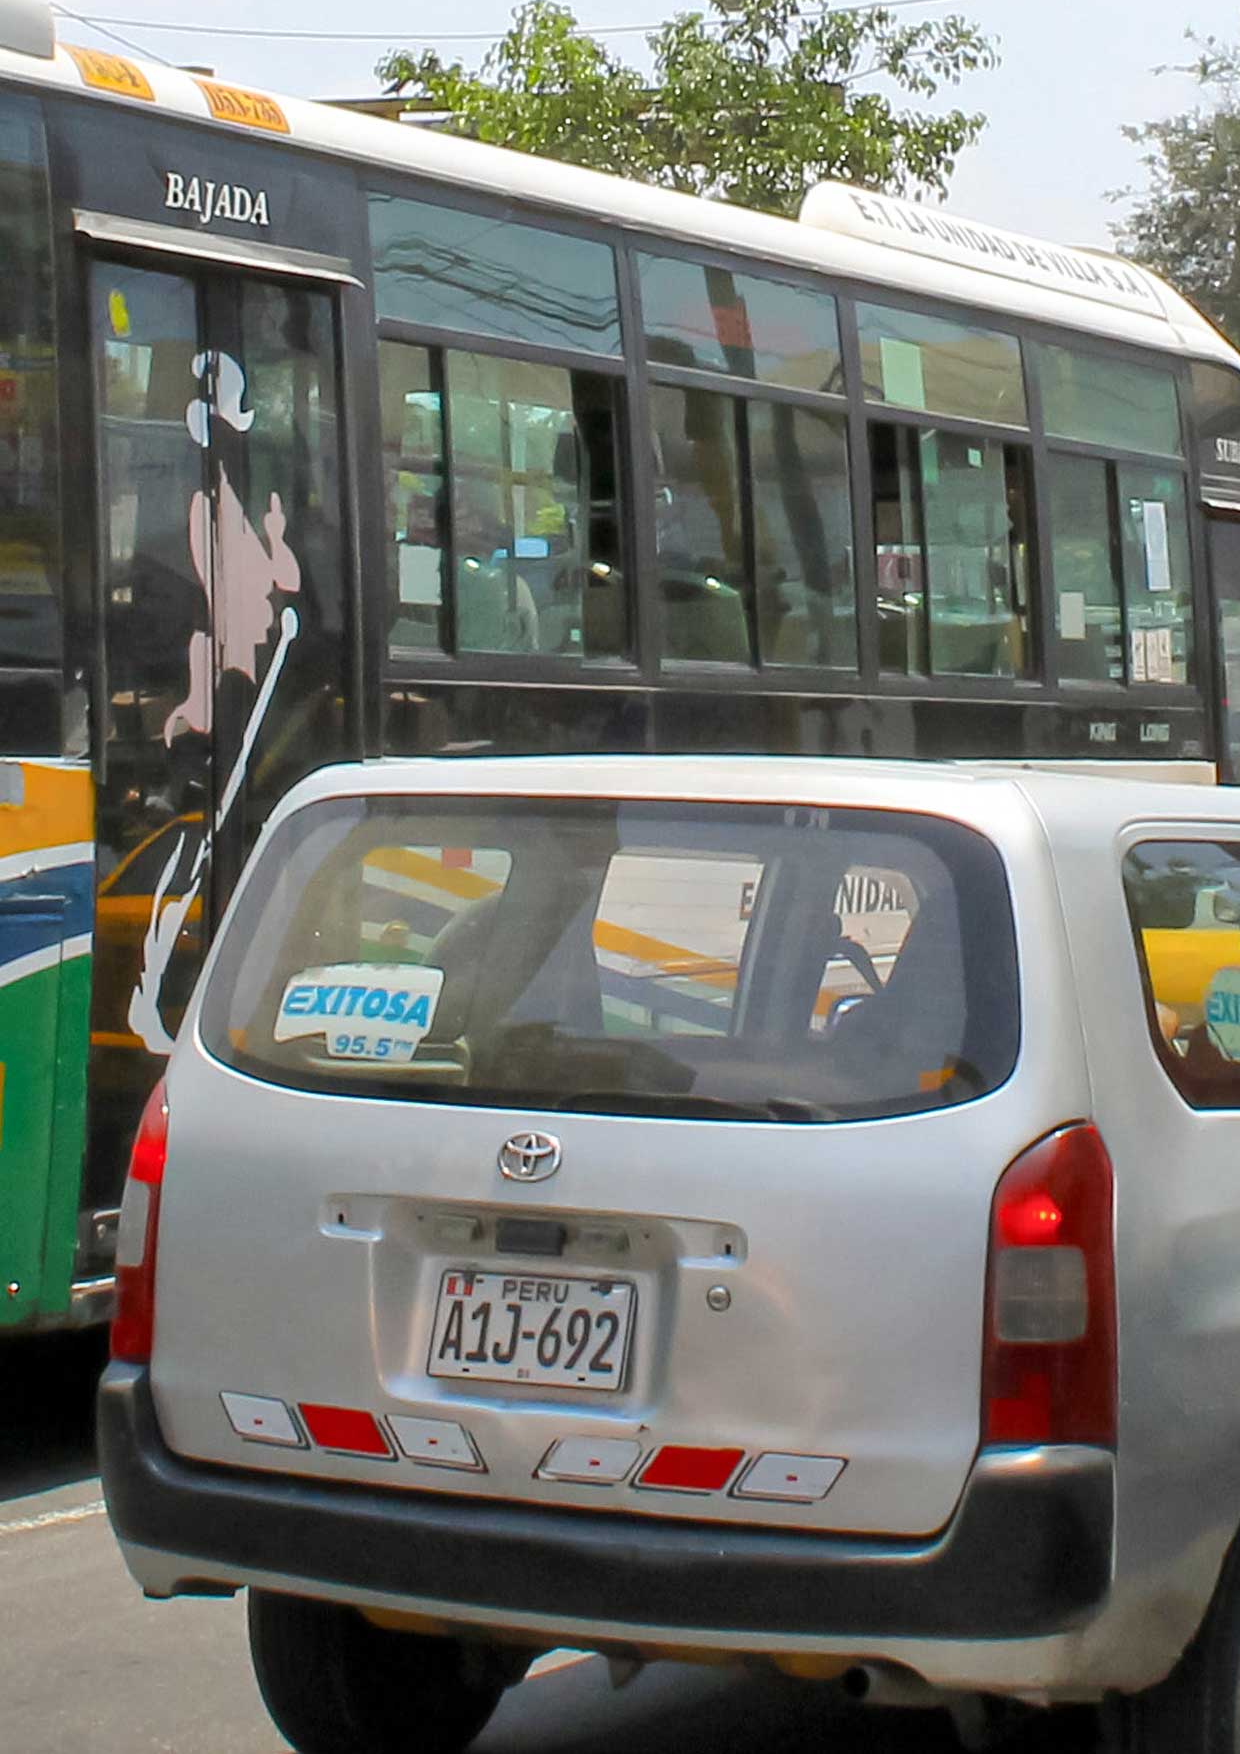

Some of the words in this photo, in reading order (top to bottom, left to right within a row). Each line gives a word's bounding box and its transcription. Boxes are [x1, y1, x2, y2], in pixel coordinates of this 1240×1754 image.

[165, 171, 270, 225] BAJADA
[897, 209, 934, 239] LA
[927, 215, 1016, 262] UNIDAD
[1012, 241, 1050, 271] DE
[1046, 249, 1108, 288] VILLA
[283, 985, 430, 1028] EXITOSA
[335, 1034, 392, 1056] 95.5
[502, 1279, 569, 1303] PERU
[438, 1300, 620, 1373] A1J-692
